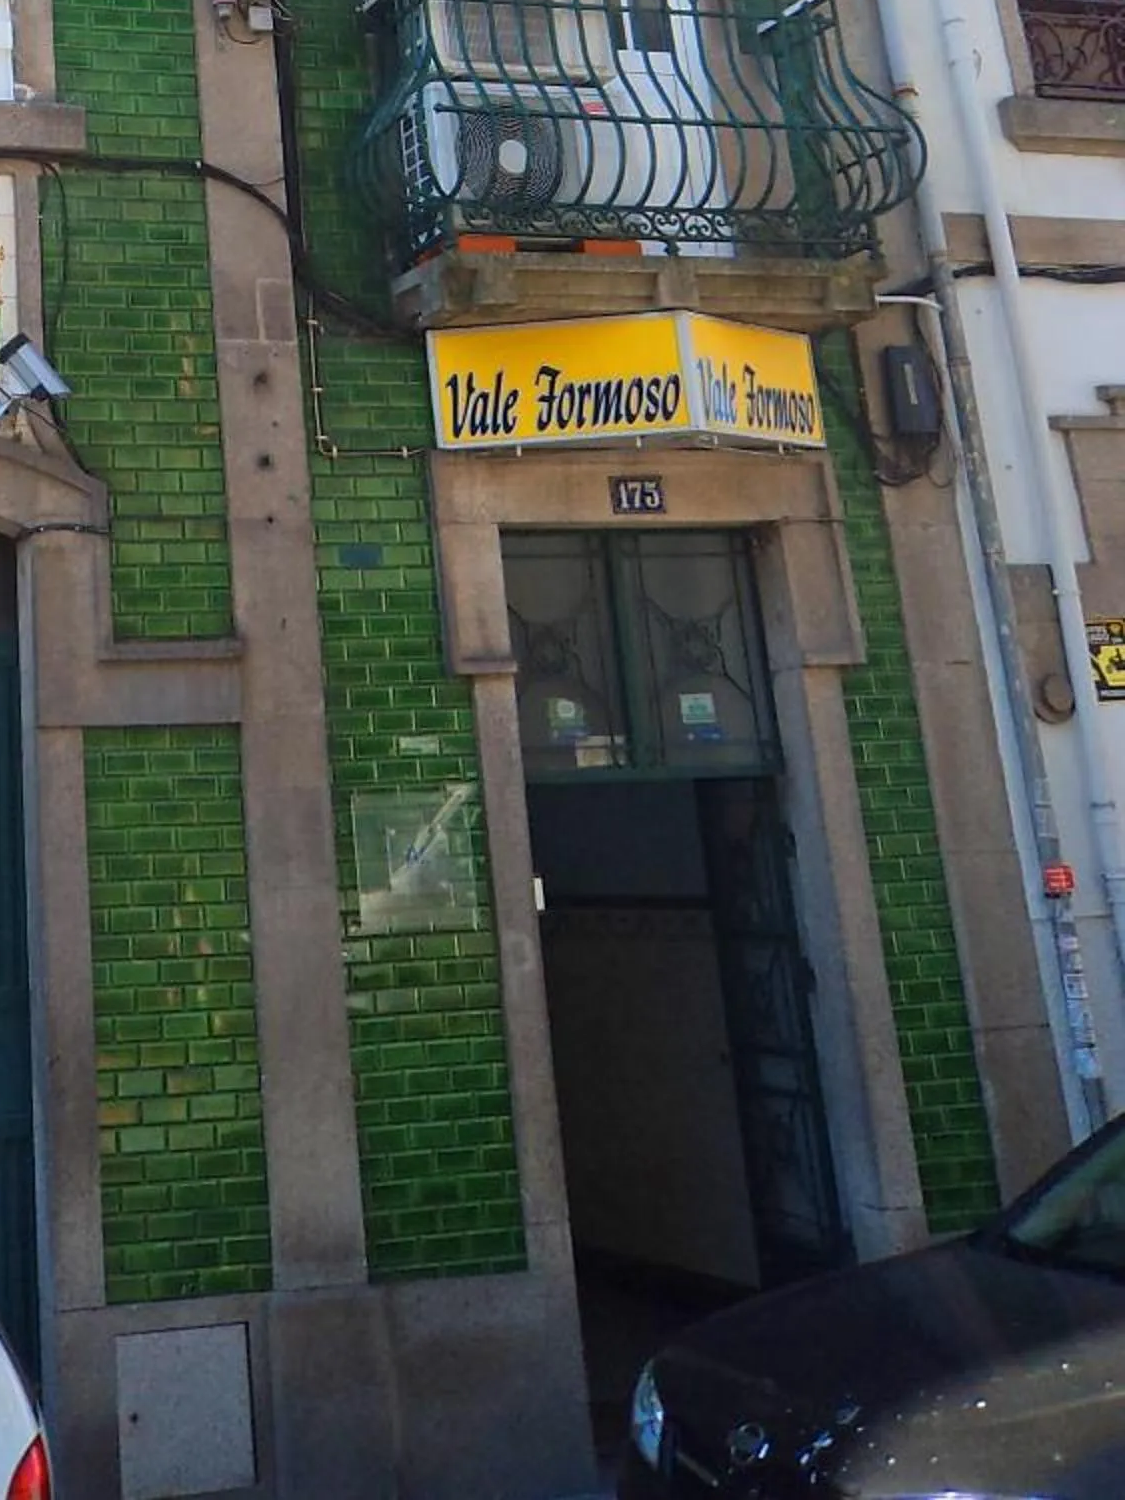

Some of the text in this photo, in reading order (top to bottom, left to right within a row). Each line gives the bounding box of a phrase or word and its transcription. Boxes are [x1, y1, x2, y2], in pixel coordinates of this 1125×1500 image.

[445, 365, 681, 439] Vale Formoso
[695, 356, 816, 435] Vale Formoso
[618, 481, 661, 509] 175
